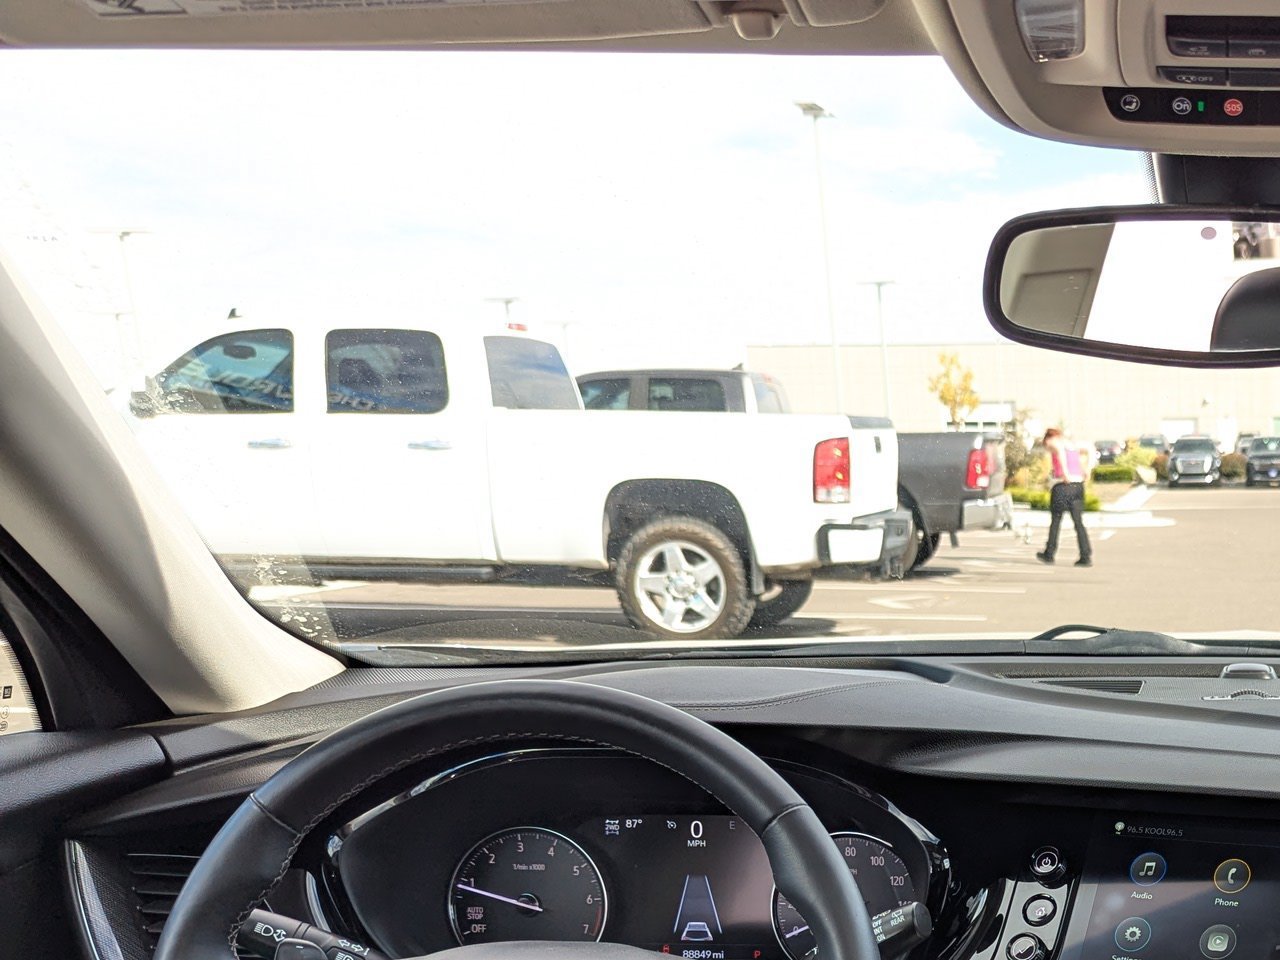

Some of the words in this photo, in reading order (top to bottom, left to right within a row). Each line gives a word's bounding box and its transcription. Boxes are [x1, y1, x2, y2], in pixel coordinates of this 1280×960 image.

[1226, 103, 1242, 112] SOS
[625, 819, 643, 828] 87°
[690, 820, 703, 839] 0
[517, 843, 524, 852] 3
[547, 847, 555, 857] 4
[845, 846, 857, 857] 80
[488, 854, 496, 864] 2
[870, 856, 885, 866] 100
[573, 866, 580, 876] 5
[470, 878, 475, 887] 1
[890, 875, 905, 886] 120
[586, 895, 593, 905] 6
[1131, 891, 1153, 900] Audio
[1214, 898, 1239, 907] Phone
[872, 919, 882, 927] OFF
[890, 915, 905, 926] REAR
[471, 924, 487, 933] OFF
[583, 924, 589, 934] 7
[873, 927, 883, 935] INT
[682, 949, 712, 959] 88849
[712, 950, 724, 959] mi
[754, 950, 761, 958] P
